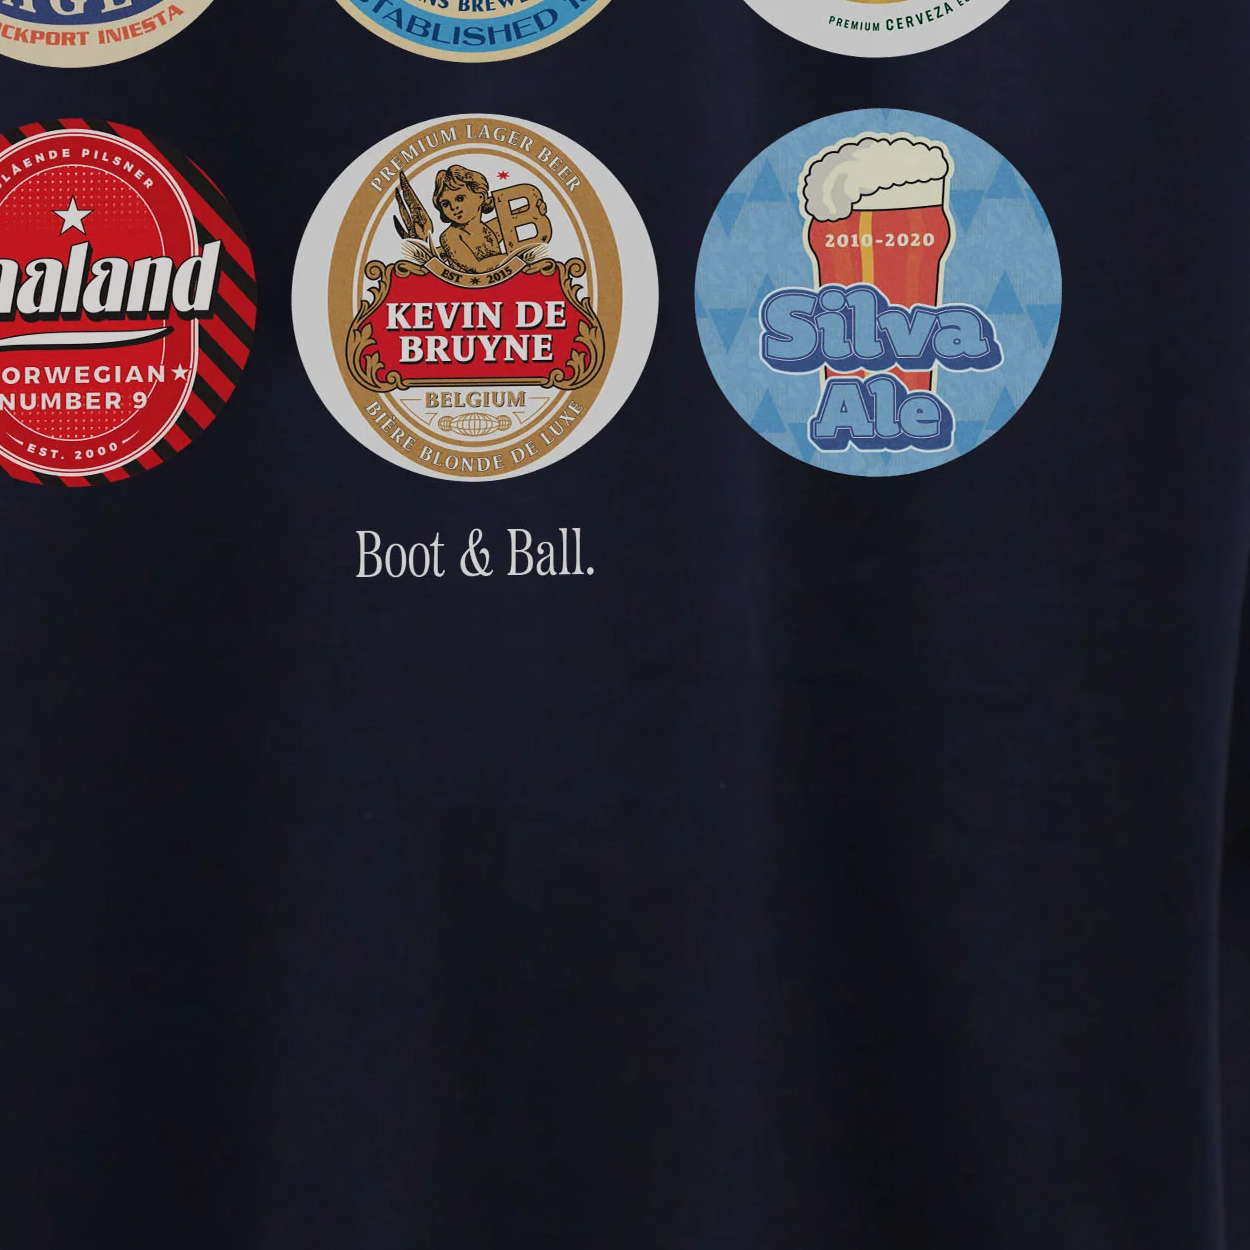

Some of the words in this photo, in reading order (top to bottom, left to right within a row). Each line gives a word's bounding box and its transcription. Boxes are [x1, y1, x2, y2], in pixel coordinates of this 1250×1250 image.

[98, 4, 185, 45] INIESTA
[828, 15, 880, 32] PREMIUM
[885, 1, 953, 31] CERVEZA
[82, 148, 154, 190] PILSNER
[371, 126, 458, 192] PREMIUM
[466, 124, 534, 152] LAGER
[536, 146, 583, 193] BEER
[825, 233, 935, 248] 2010-2020
[441, 269, 462, 282] EST
[486, 266, 512, 283] 2015
[386, 301, 503, 331] KEVIN
[516, 300, 567, 329] DE
[760, 283, 1003, 373] Silva
[399, 334, 554, 364] BRUYNE
[133, 391, 148, 410] 9
[424, 390, 527, 409] BELGIUM
[810, 374, 954, 451] Ale
[26, 442, 65, 460] EST.
[74, 442, 119, 460] 2000
[365, 400, 413, 452] BIÈRE
[419, 445, 505, 472] BLONDE
[511, 441, 537, 465] DE
[540, 399, 584, 445] LUXE
[355, 530, 446, 578] Boot
[460, 528, 494, 577] &
[506, 527, 595, 576] Ball.
